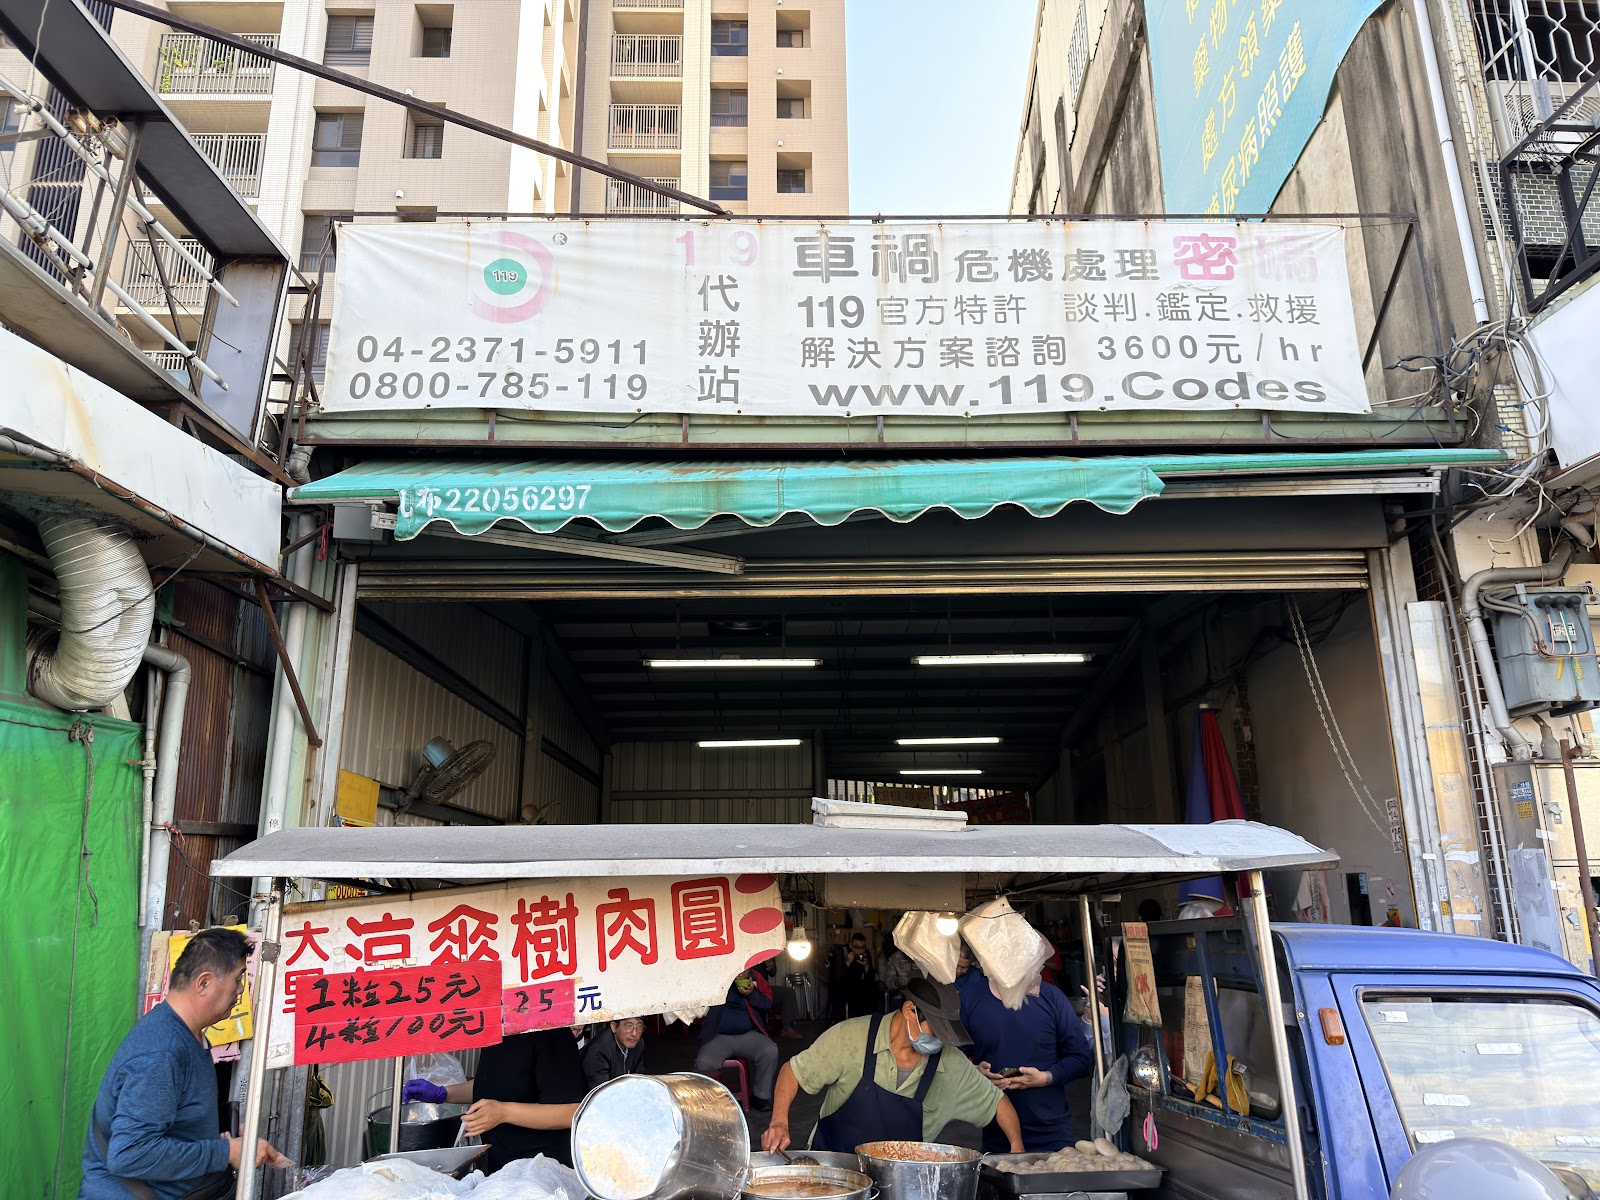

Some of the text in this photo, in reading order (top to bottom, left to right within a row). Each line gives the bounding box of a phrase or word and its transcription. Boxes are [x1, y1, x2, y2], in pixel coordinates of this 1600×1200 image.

[676, 231, 758, 267] 19
[493, 269, 518, 282] 119
[797, 296, 865, 329] 119
[876, 293, 1028, 326] 官方特許
[356, 335, 648, 365] 04-2371-5911
[697, 274, 741, 404] 代辦站
[800, 335, 1067, 369] 解決方案諮詢
[348, 371, 649, 400] 0800-785-119
[808, 371, 1327, 406] www.119.Codes
[306, 972, 481, 1014] 1粒25元
[515, 985, 603, 1013] 25 元
[305, 1008, 485, 1052] 4粒100元
